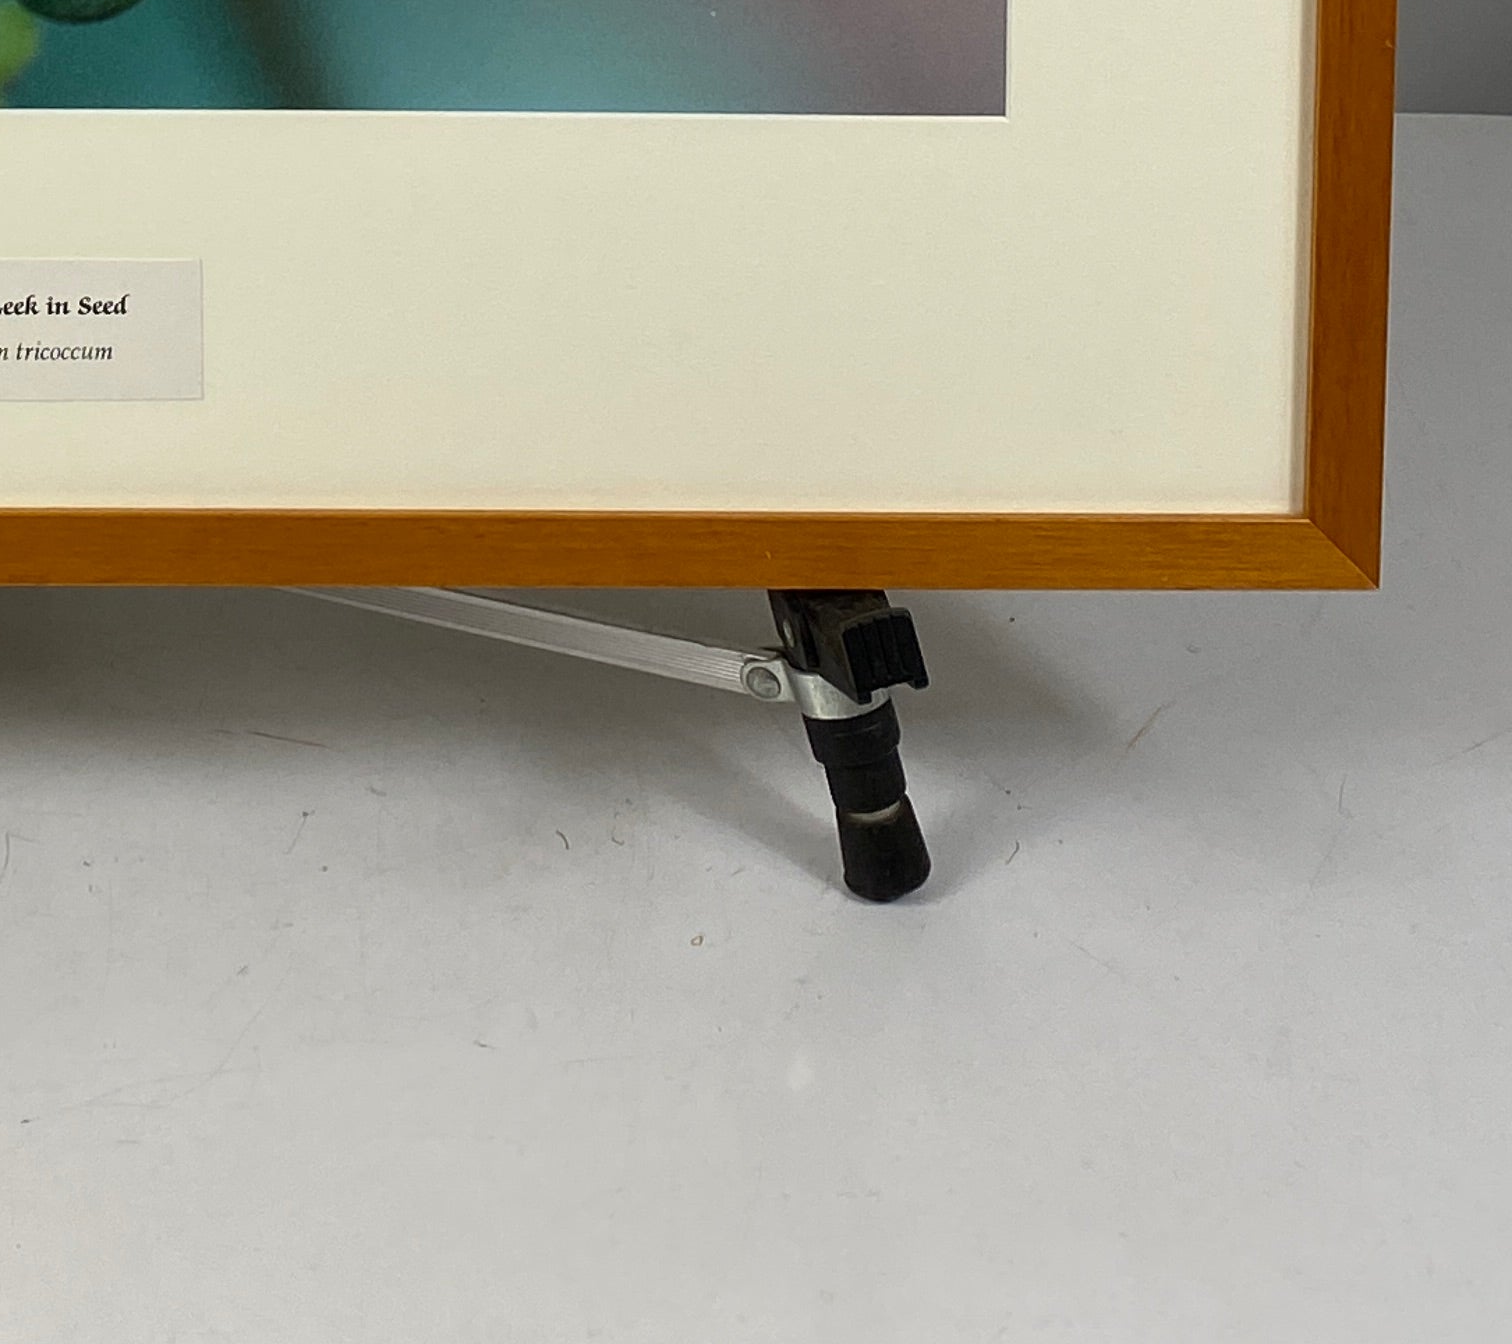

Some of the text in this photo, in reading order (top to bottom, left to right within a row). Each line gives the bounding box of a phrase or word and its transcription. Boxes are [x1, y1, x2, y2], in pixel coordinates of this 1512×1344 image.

[45, 295, 70, 316] in
[77, 293, 130, 316] Seed
[15, 341, 113, 361] tricoccum
